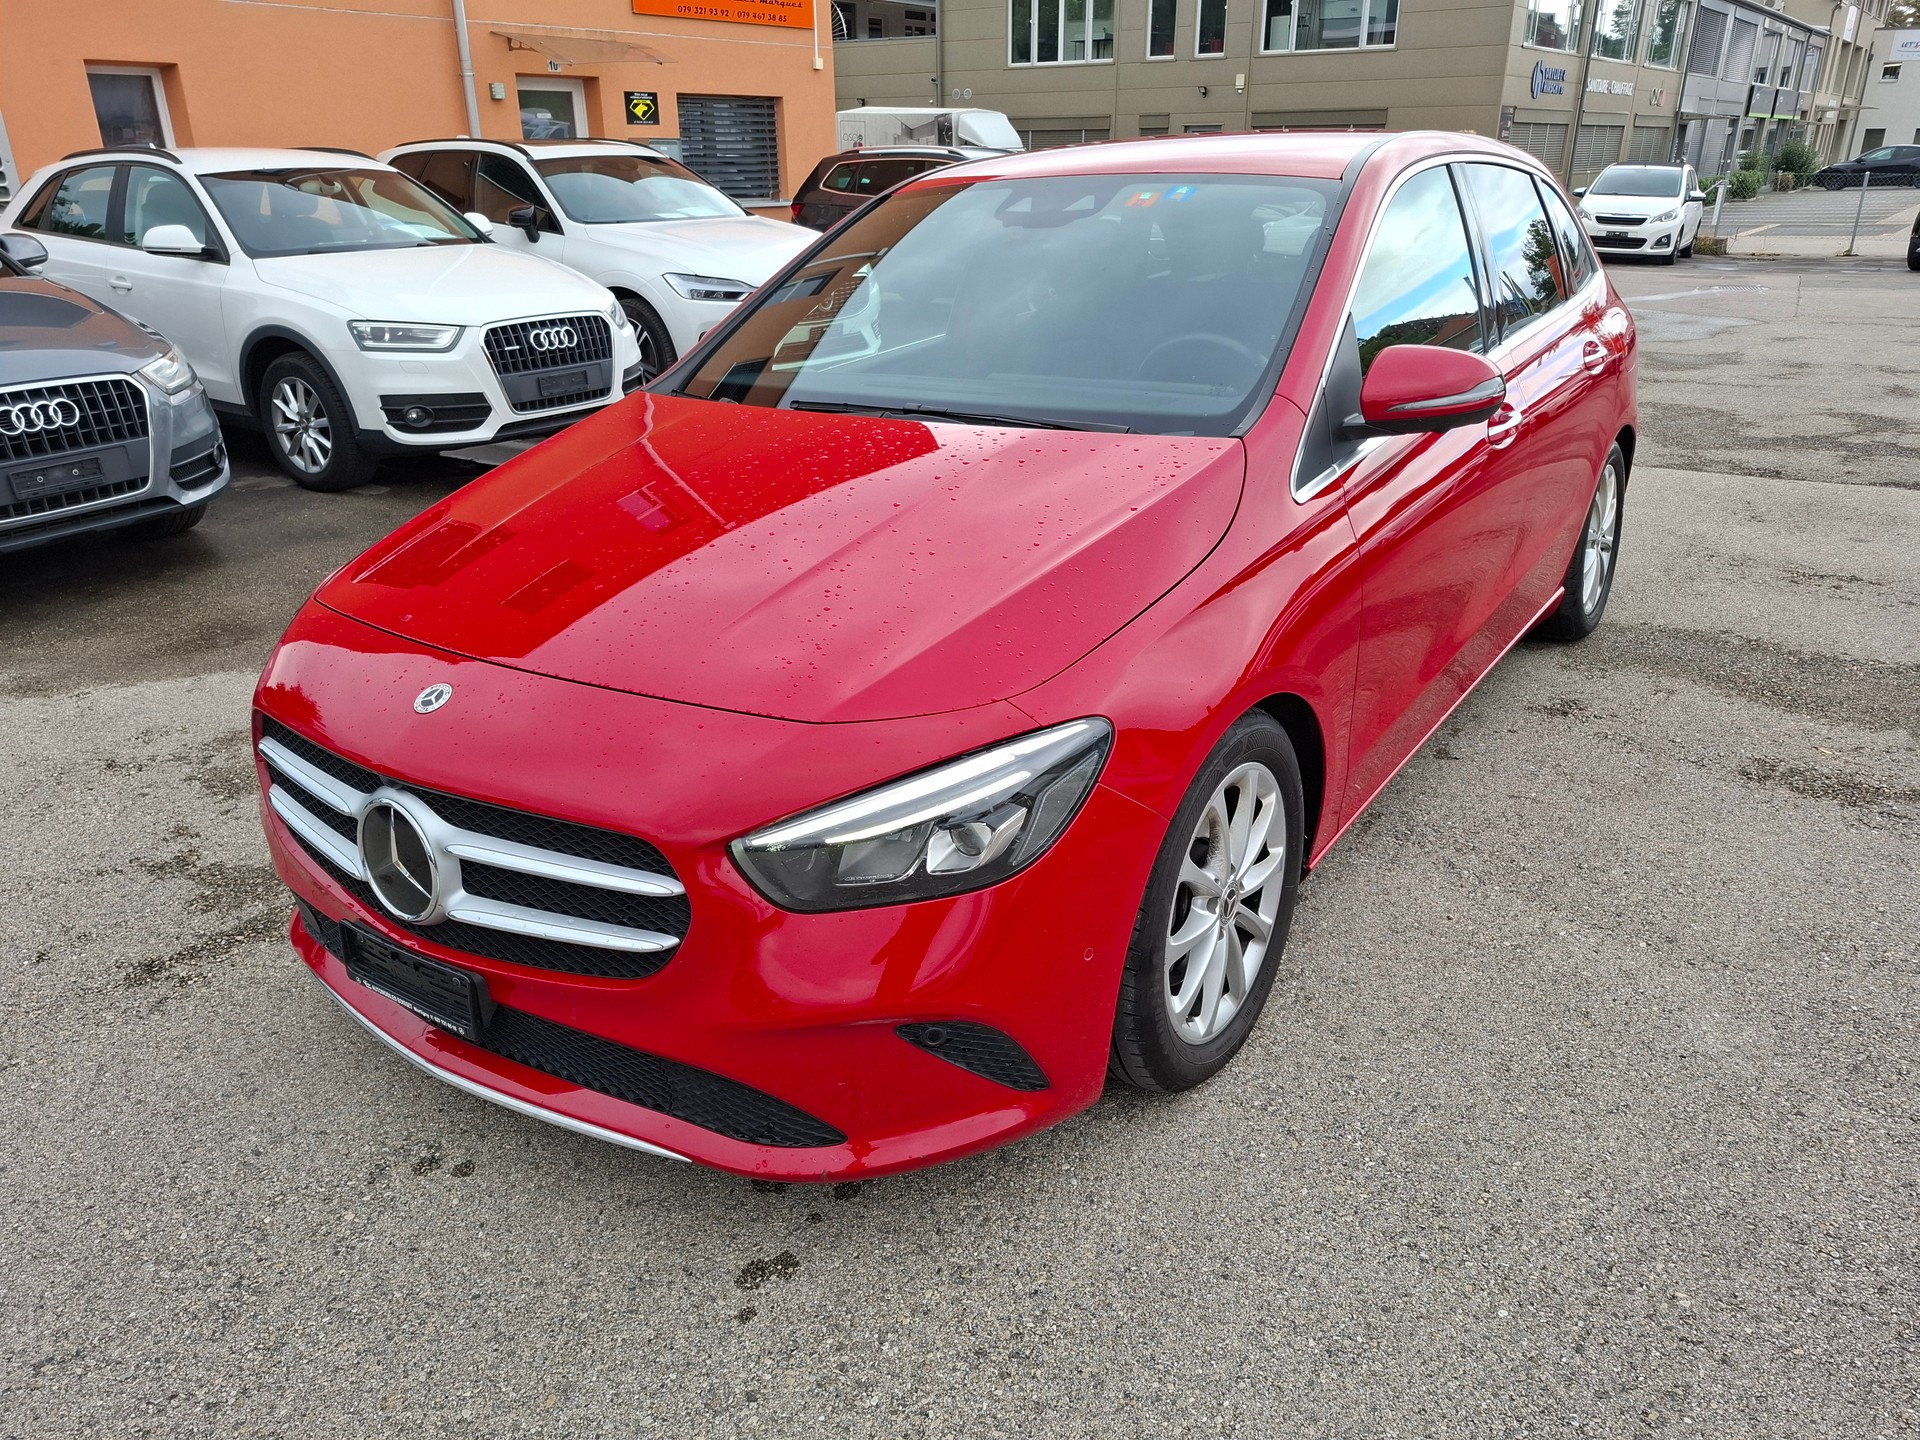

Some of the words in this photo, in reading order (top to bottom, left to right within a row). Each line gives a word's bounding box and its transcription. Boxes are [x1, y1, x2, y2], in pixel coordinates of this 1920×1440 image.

[677, 5, 692, 13] 079
[708, 7, 718, 16] 93
[720, 8, 729, 17] 92
[737, 10, 750, 19] 079
[768, 13, 776, 21] 38
[778, 14, 787, 23] 85
[1586, 78, 1609, 94] SANITAIRE
[1611, 80, 1634, 96] CHAUFFAGE
